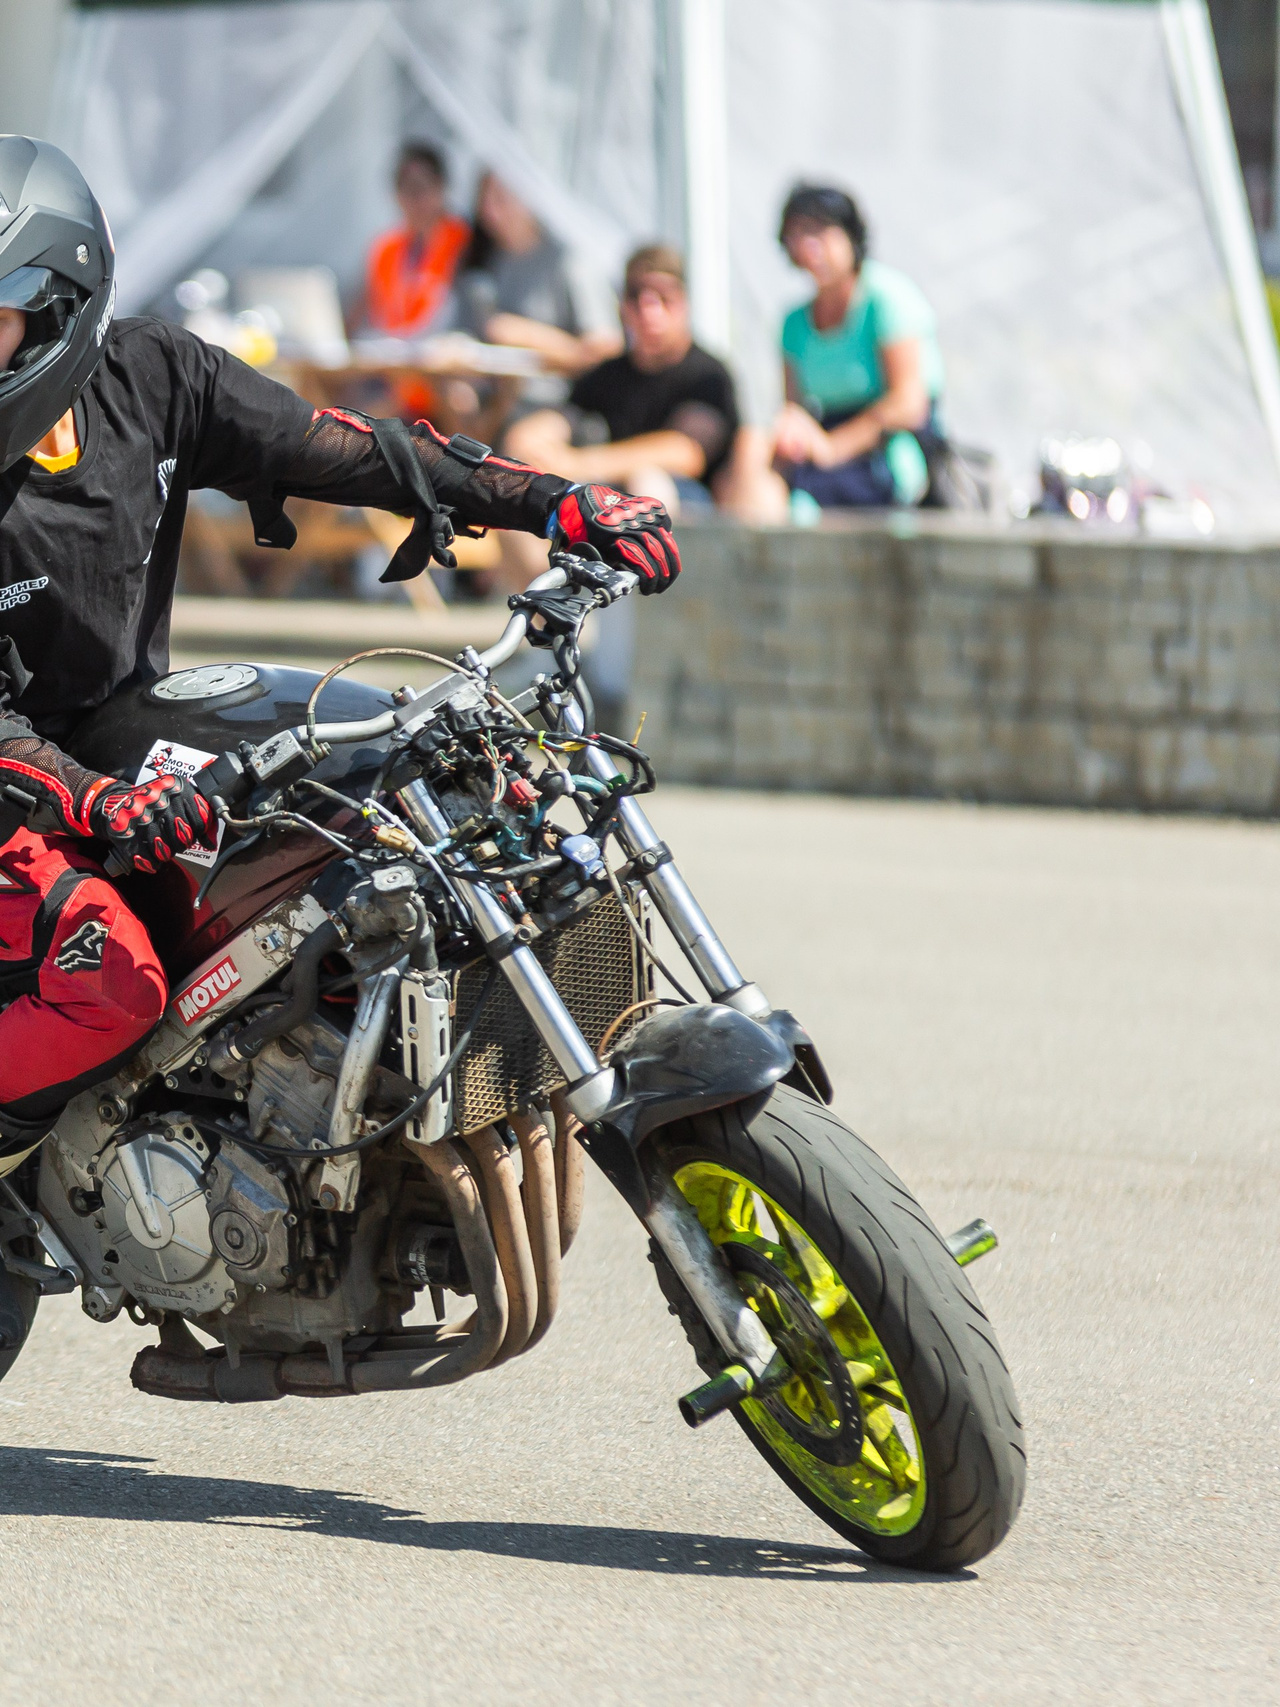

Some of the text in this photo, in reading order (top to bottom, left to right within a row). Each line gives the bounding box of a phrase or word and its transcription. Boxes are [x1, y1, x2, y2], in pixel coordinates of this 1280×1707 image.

[167, 758, 196, 772] MOTO
[178, 961, 241, 1022] MOTUL
[133, 1282, 192, 1301] HONDA
